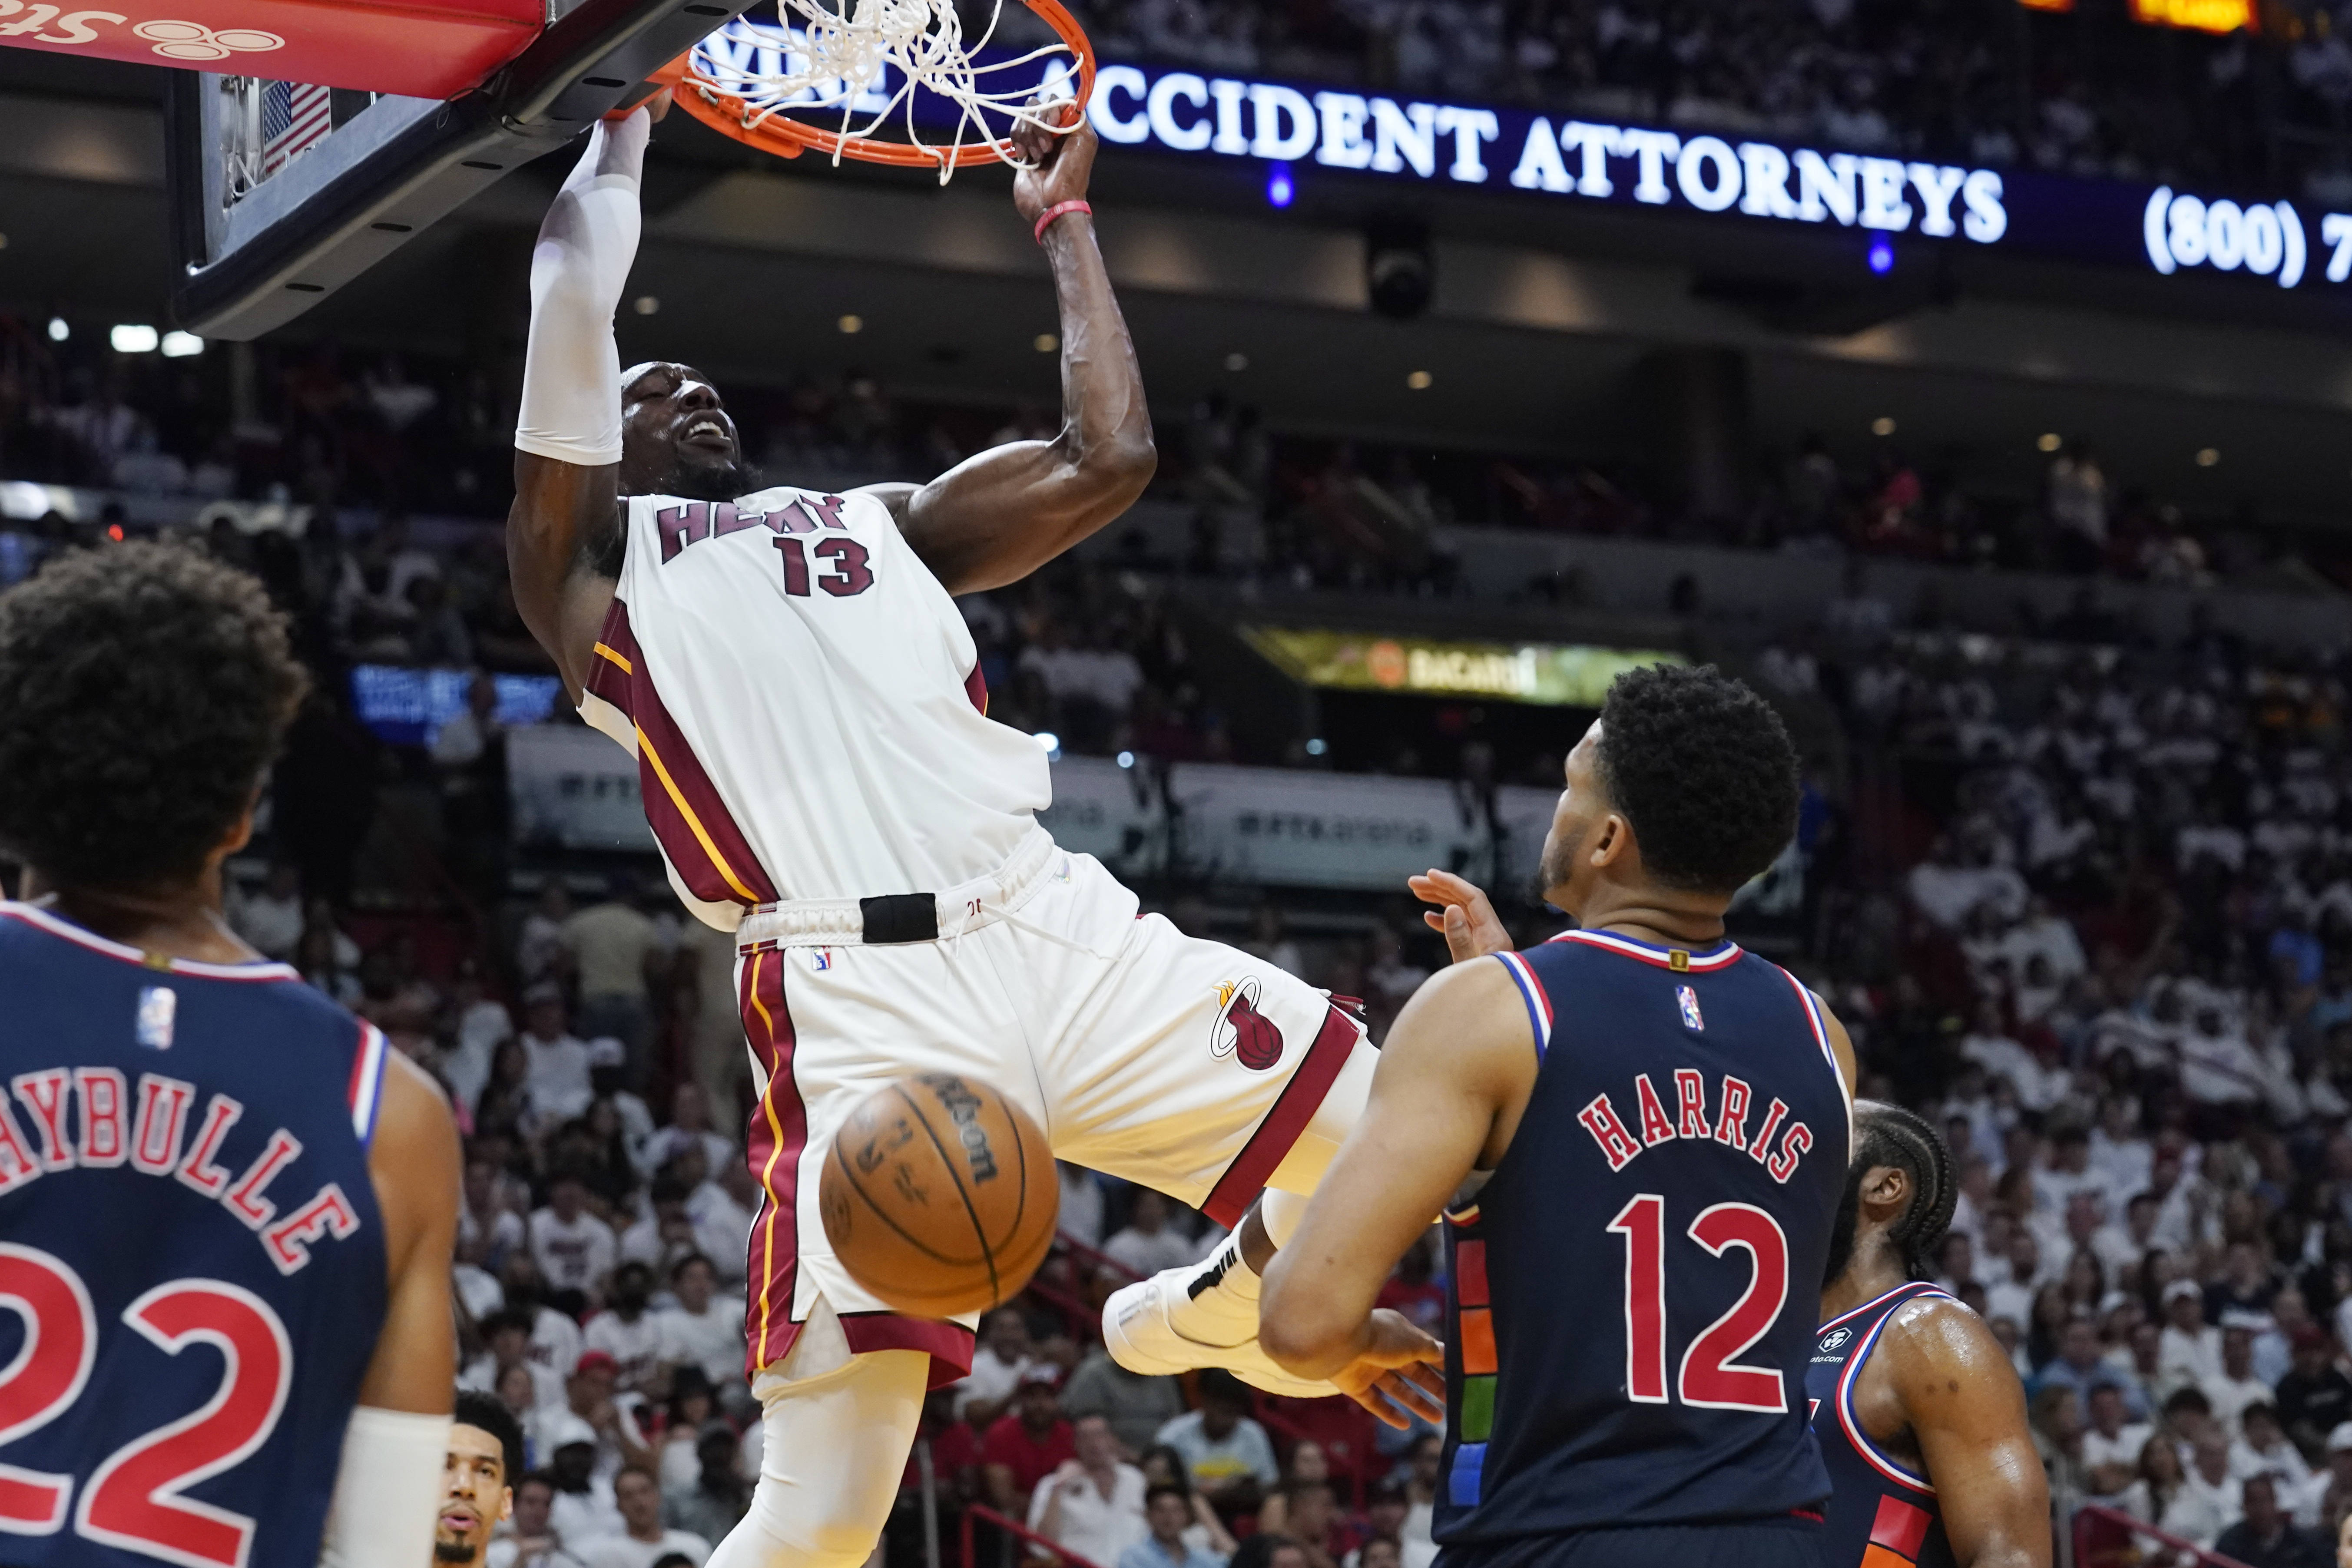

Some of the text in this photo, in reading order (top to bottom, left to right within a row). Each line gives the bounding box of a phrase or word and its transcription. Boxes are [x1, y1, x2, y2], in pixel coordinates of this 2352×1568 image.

[1510, 116, 2007, 244] ATTORNEYS
[2144, 185, 2306, 288] (800)
[2322, 213, 2352, 283] 7
[773, 537, 875, 597] 13
[1577, 1068, 1813, 1184] HARRIS
[1606, 1194, 1788, 1413] 12
